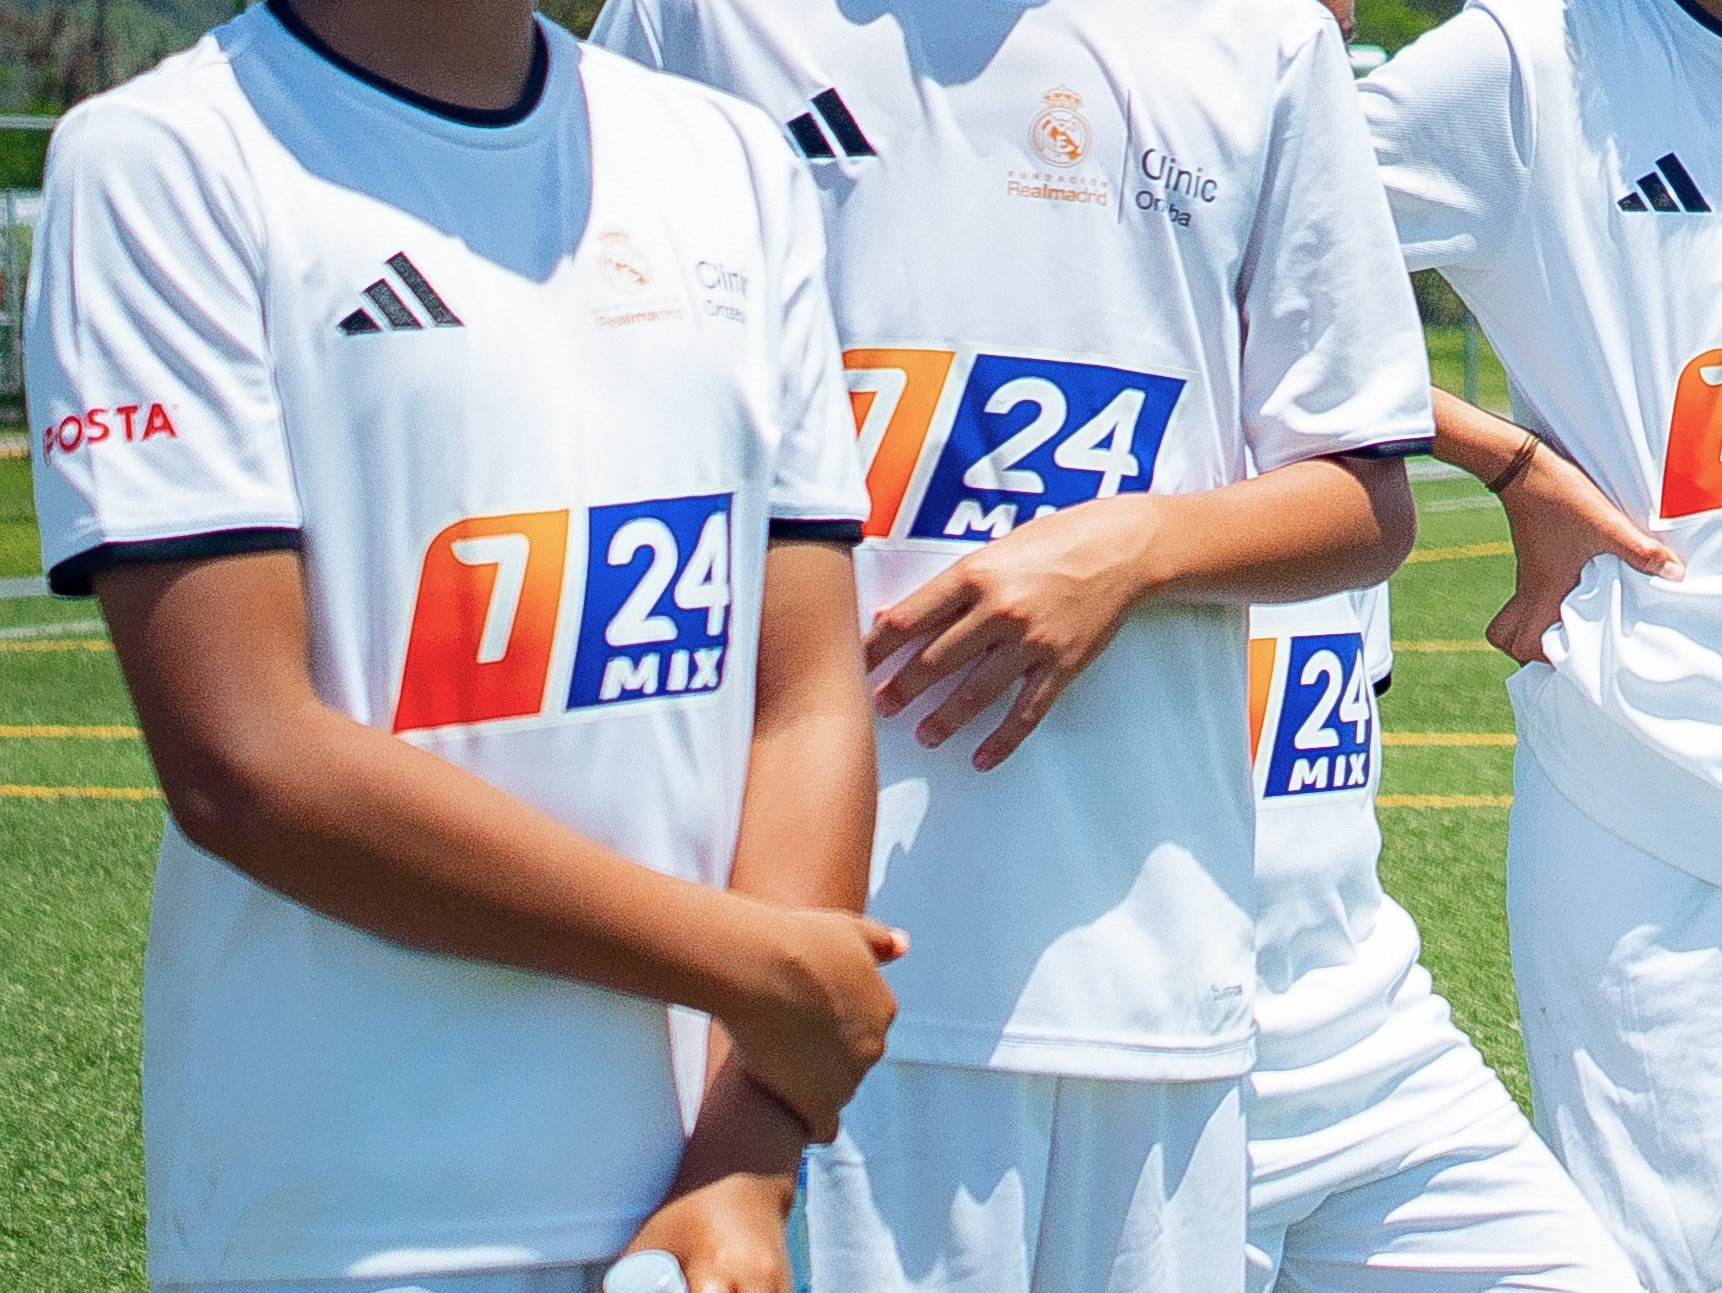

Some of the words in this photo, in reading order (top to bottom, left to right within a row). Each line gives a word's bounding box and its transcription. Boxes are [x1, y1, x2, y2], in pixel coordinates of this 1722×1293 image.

[1141, 148, 1218, 203] Clinic
[43, 402, 177, 467] POSTA
[963, 376, 1147, 499] 24
[605, 516, 733, 648] 24
[600, 647, 724, 700] MIX
[1294, 648, 1370, 750] 24
[1287, 752, 1367, 791] MIX
